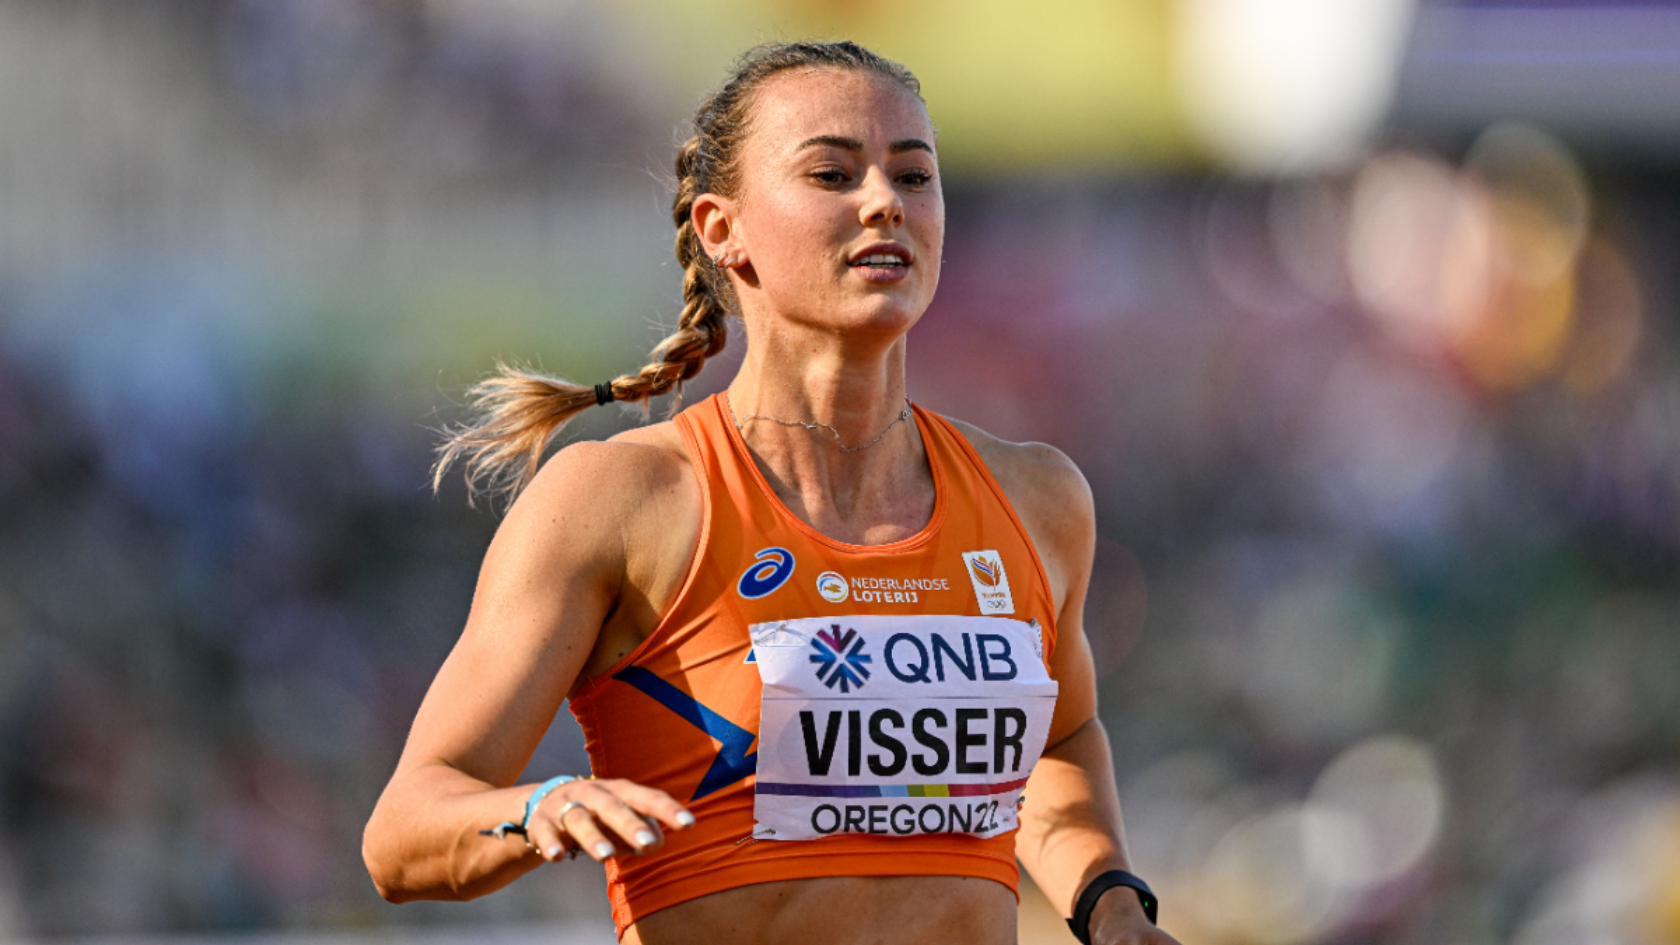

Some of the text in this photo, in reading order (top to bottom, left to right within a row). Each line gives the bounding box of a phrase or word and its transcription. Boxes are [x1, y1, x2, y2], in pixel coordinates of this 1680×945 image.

[851, 577, 950, 590] NEDERLANDSE
[852, 590, 918, 603] LOTERIJ
[884, 632, 1018, 683] QNB
[799, 708, 1027, 776] VISSER
[811, 800, 998, 834] OREGON22
